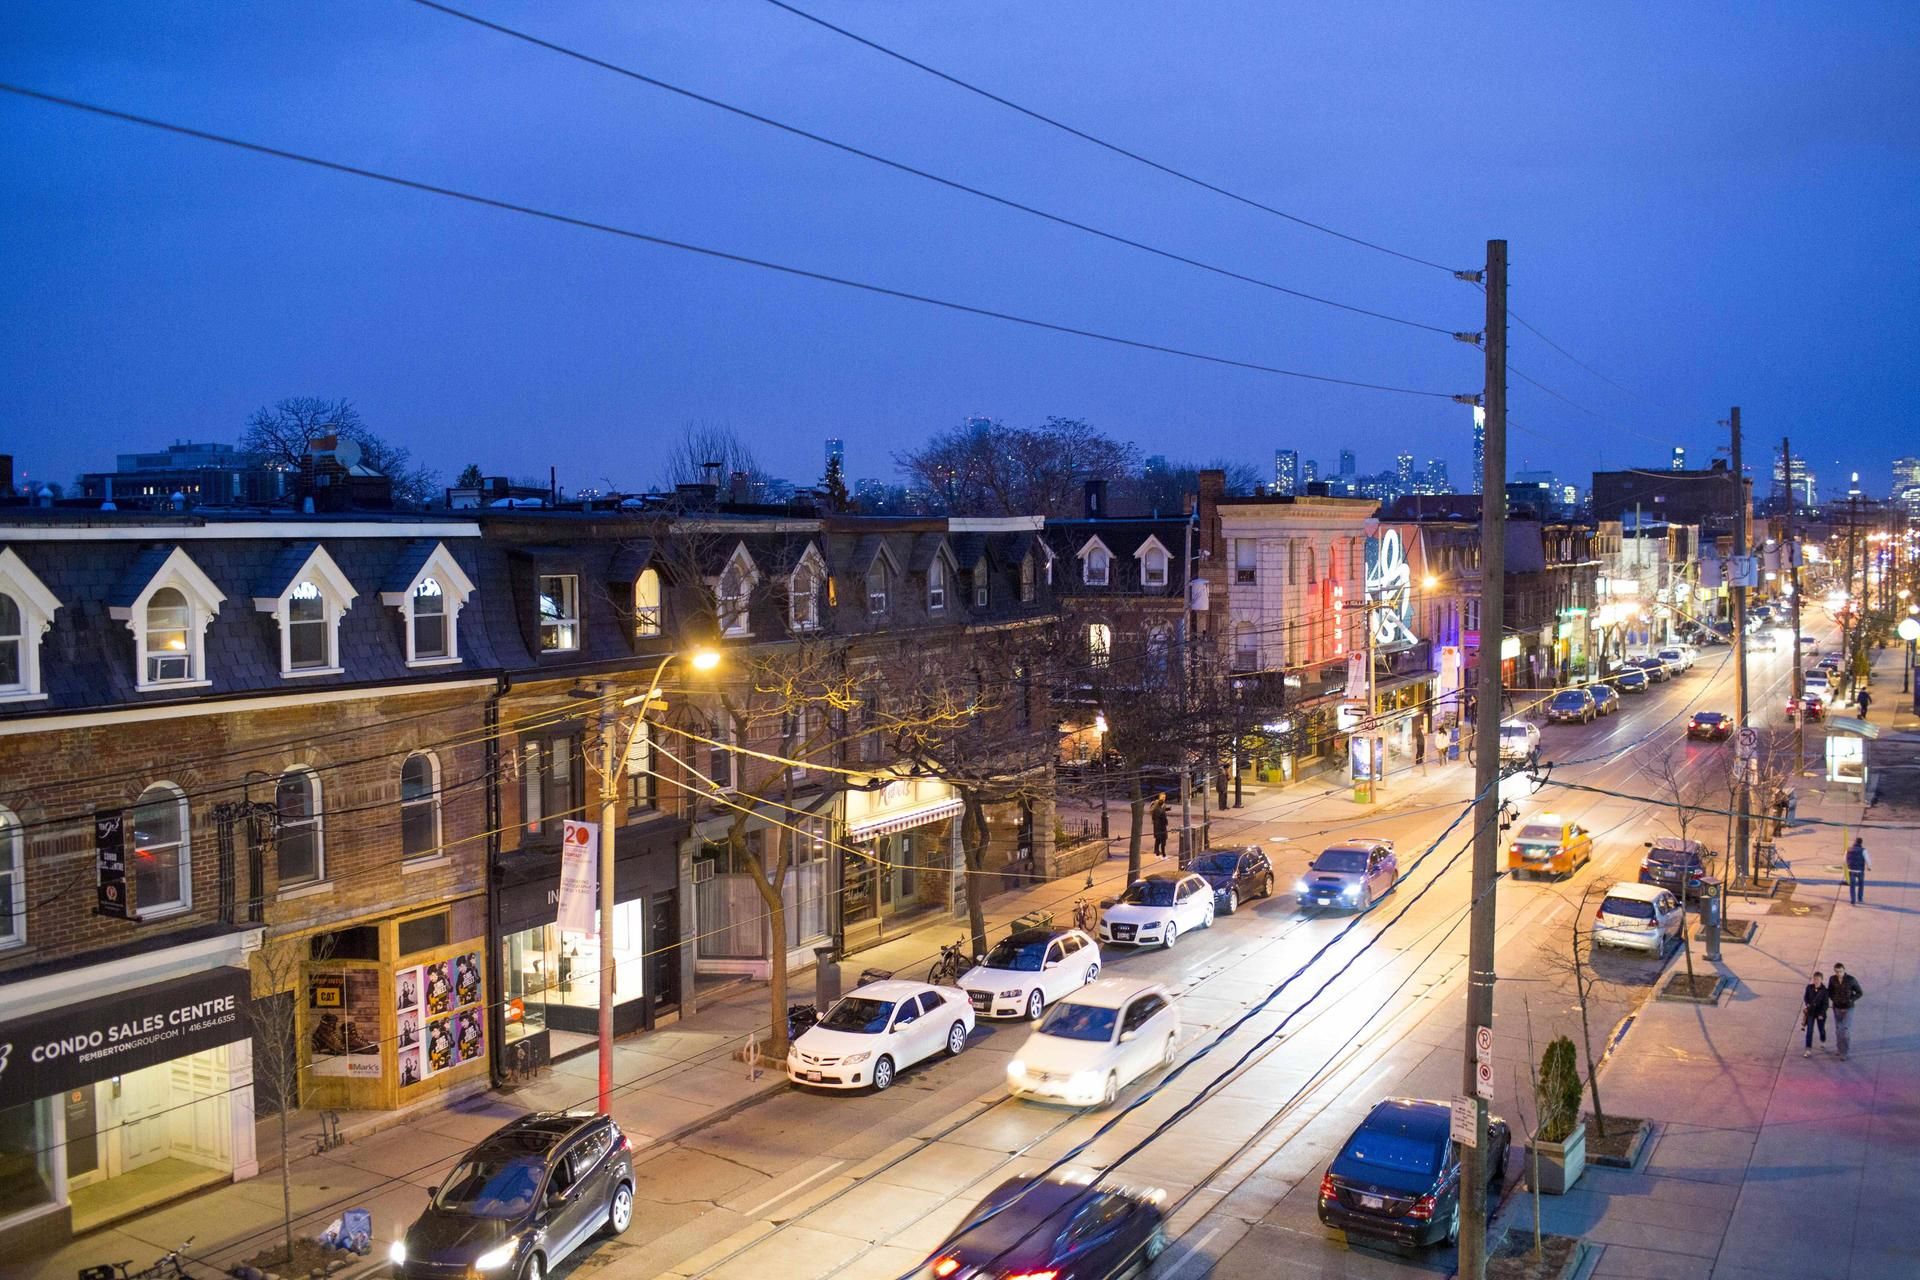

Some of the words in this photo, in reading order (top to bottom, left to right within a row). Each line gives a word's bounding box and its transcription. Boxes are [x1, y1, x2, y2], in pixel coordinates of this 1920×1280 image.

[565, 825, 589, 845] 20
[320, 991, 336, 1001] CAT
[31, 1031, 103, 1062] CONDO
[108, 1014, 164, 1042] SALES
[168, 995, 235, 1025] CENTRE
[188, 1013, 236, 1032] 416.564.6355
[353, 1063, 379, 1071] Mark's
